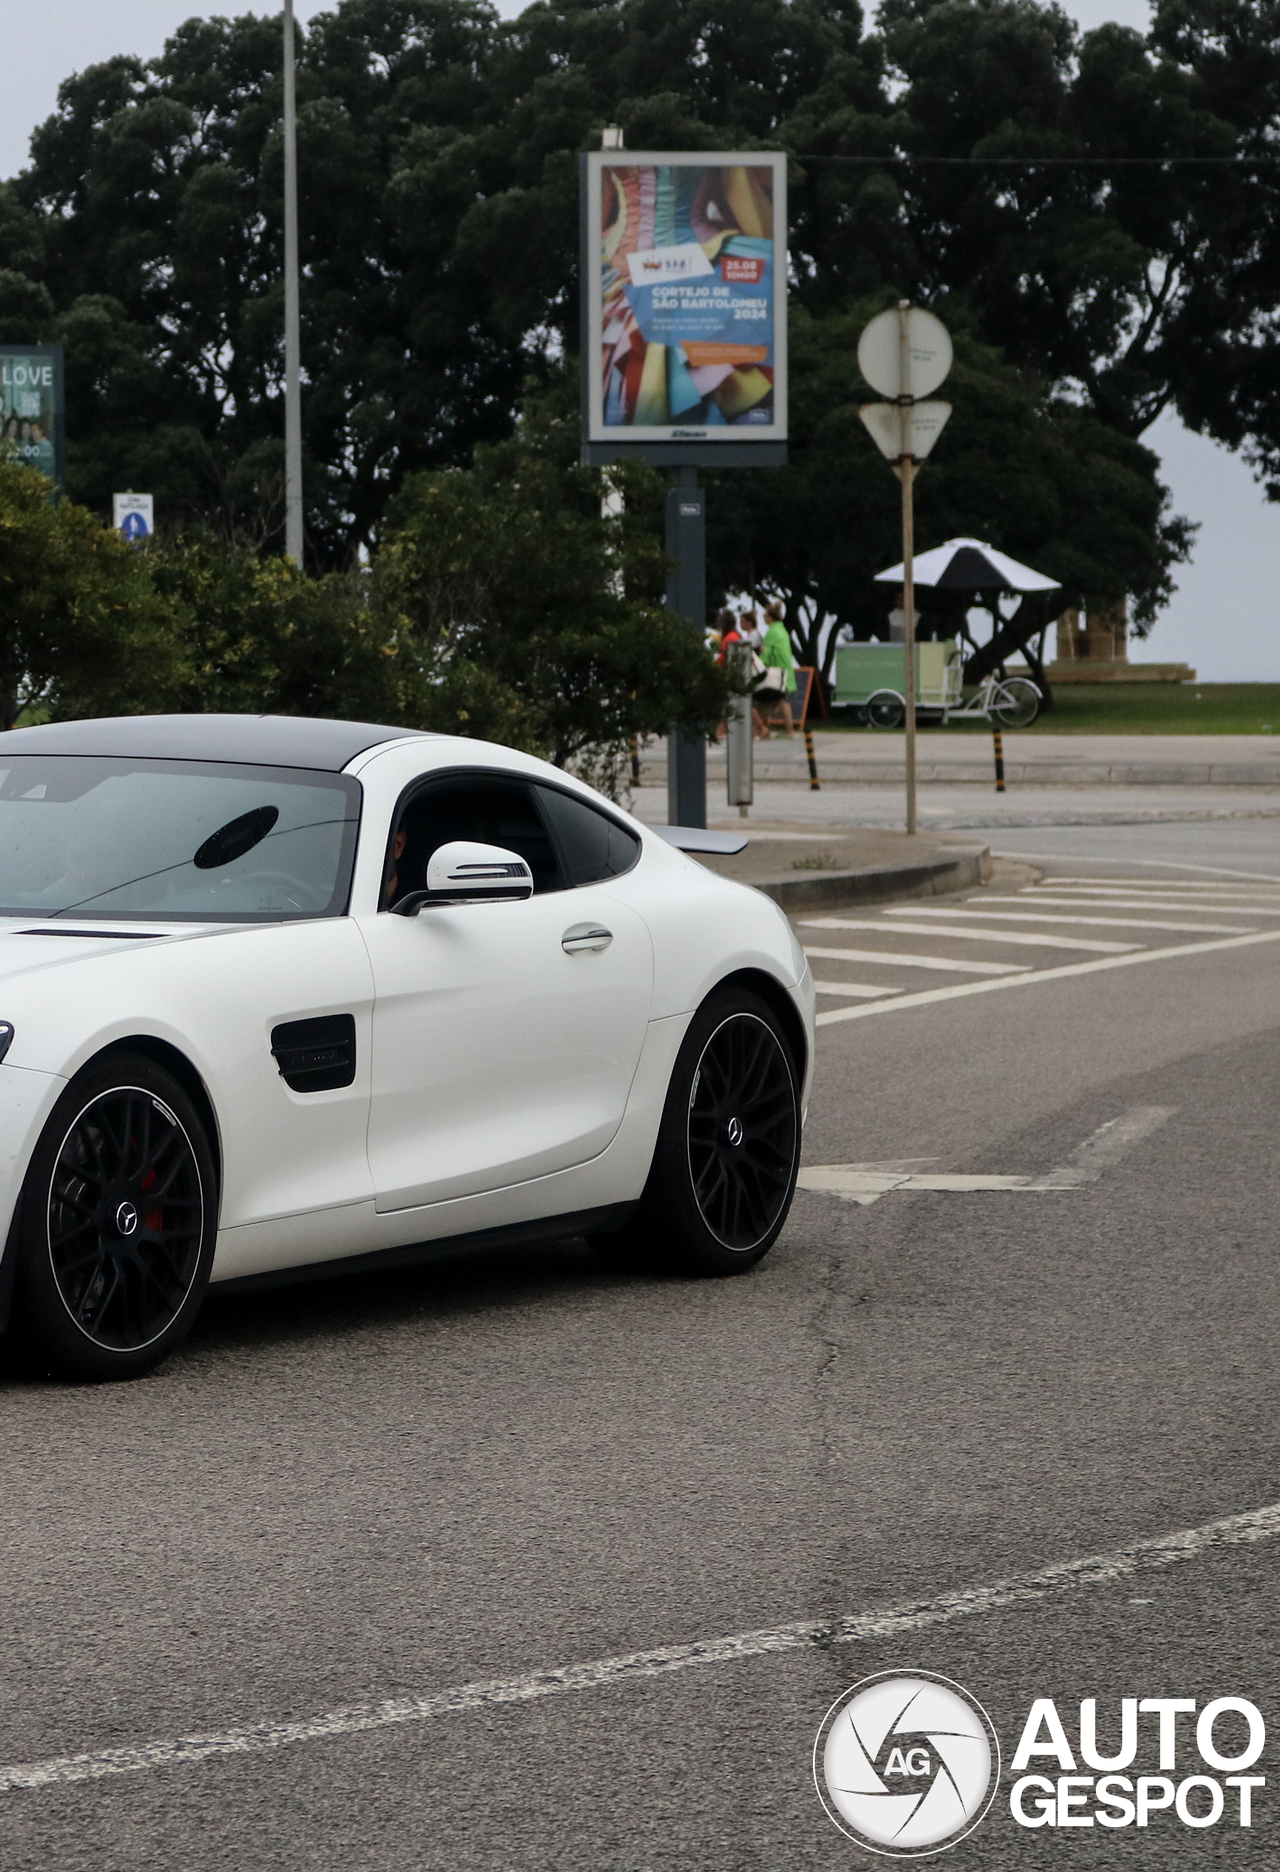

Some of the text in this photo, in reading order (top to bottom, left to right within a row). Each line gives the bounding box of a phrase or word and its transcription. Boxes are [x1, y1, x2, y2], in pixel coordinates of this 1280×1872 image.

[726, 260, 758, 270] 25.08
[652, 287, 730, 297] CORTEJO DE
[652, 296, 767, 309] SÃO BARTOLOMEU
[734, 309, 767, 320] 2024
[2, 366, 53, 386] LOVE
